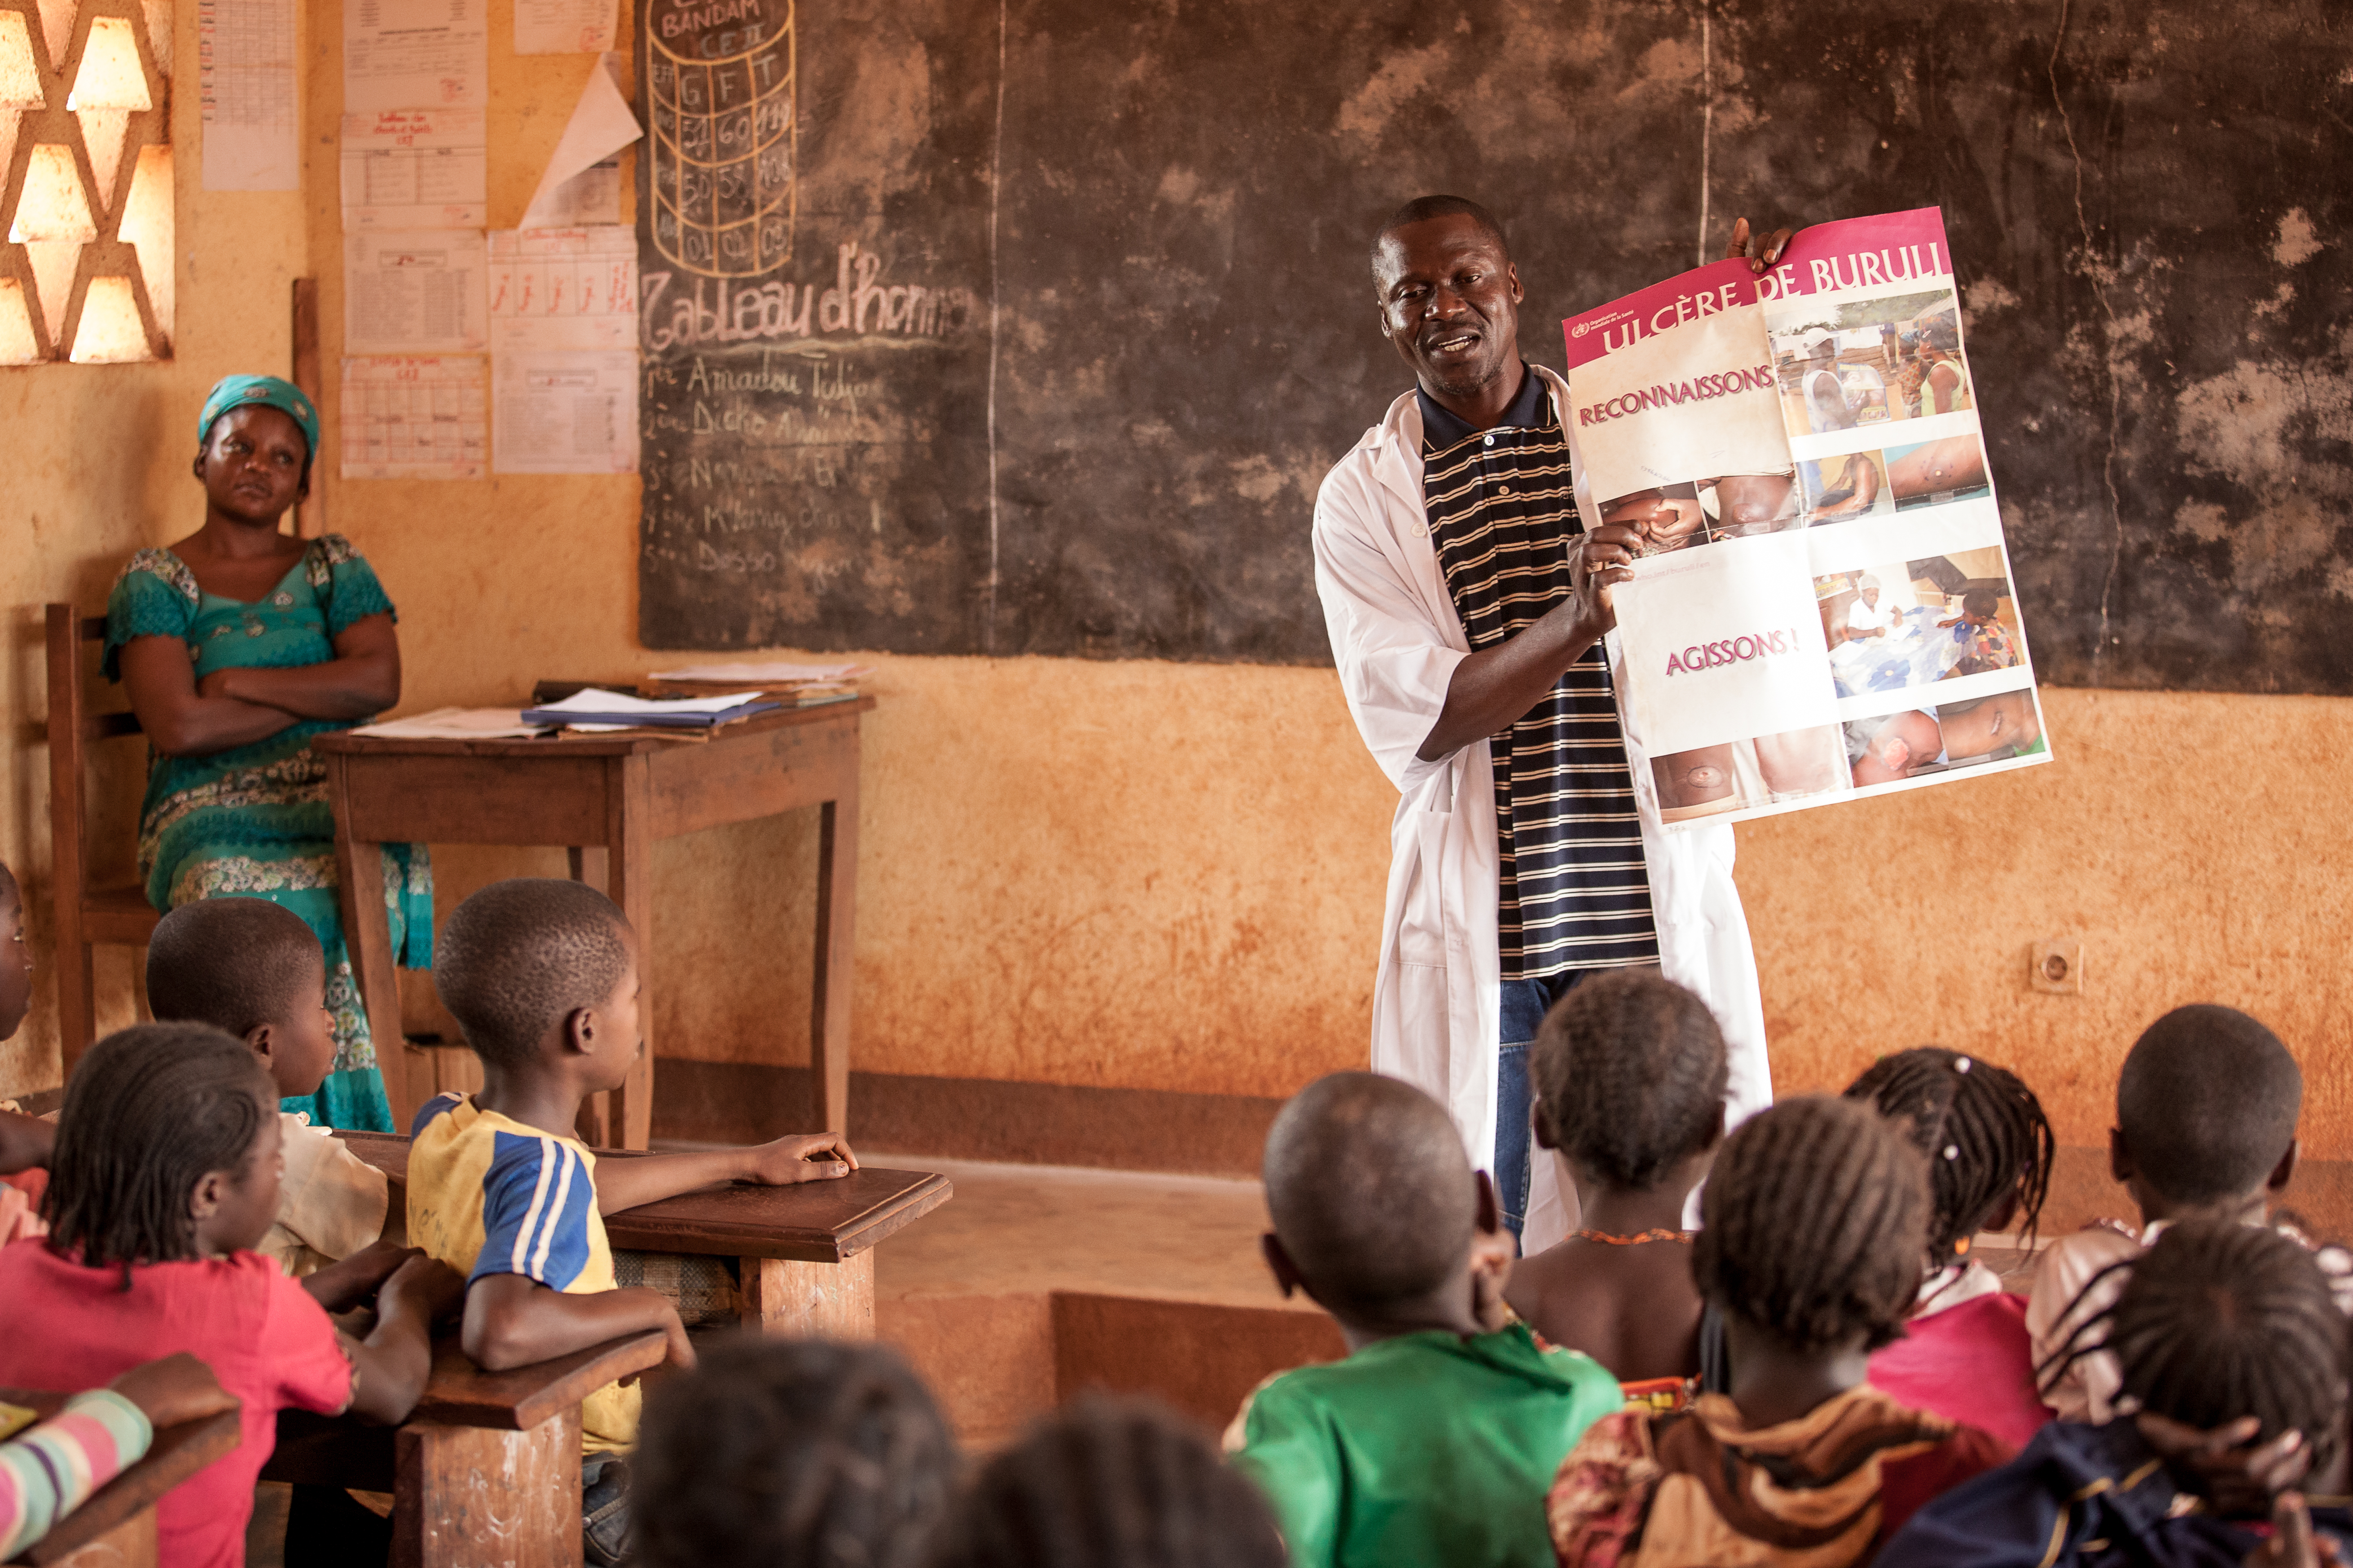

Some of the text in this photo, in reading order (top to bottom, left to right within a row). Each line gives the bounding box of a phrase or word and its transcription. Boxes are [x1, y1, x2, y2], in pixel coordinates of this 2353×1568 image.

[661, 0, 761, 38] BANDAM
[700, 31, 737, 58] CE
[680, 72, 701, 105] G
[719, 71, 737, 102] F
[751, 53, 777, 86] T
[718, 116, 751, 144] 60
[686, 231, 713, 262] 01
[641, 272, 813, 352] Tableau
[1603, 242, 1943, 355] ULCÈRE DE BURULI
[1590, 312, 1617, 326] Organisation
[1590, 320, 1610, 331] mondiale
[1621, 310, 1634, 318] Santé
[1579, 364, 1774, 427] RECONNAISSONS
[1665, 628, 1797, 676] AGISSONS !
